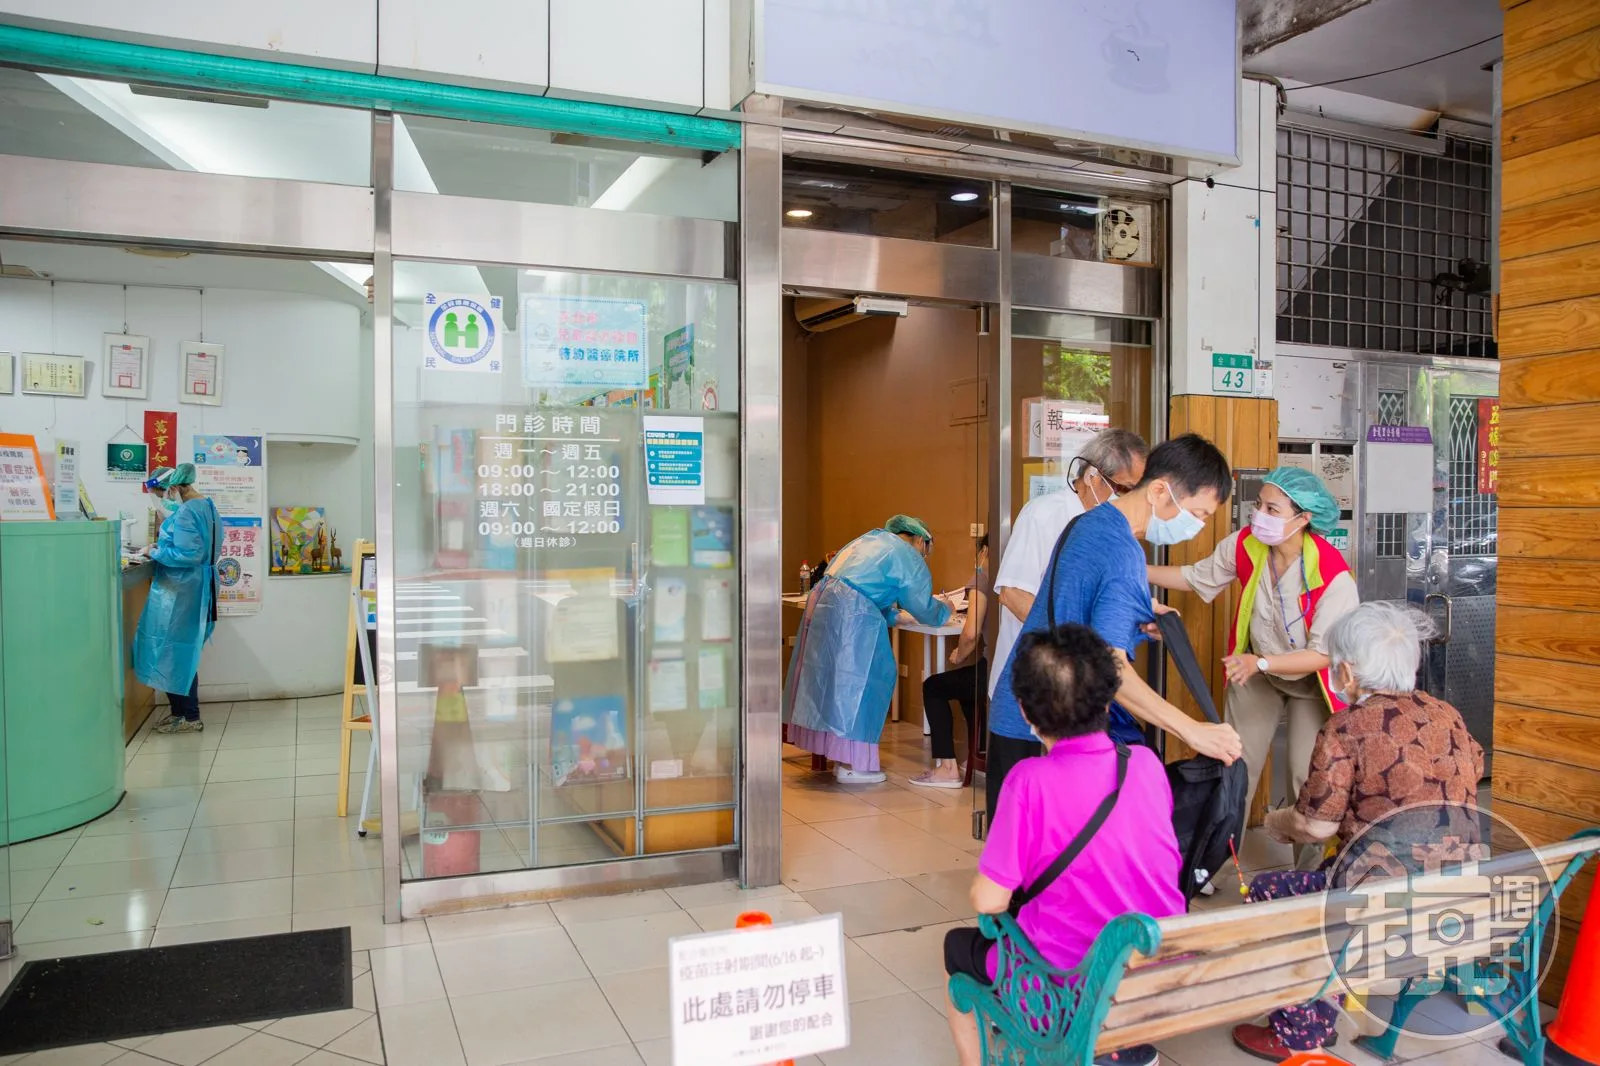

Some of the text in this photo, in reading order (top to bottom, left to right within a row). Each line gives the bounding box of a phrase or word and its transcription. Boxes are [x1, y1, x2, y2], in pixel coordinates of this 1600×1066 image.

[425, 293, 436, 304] 全
[425, 357, 436, 368] 民
[489, 360, 500, 371] 保
[1222, 371, 1245, 388] 43
[495, 414, 601, 435] 門診時間
[152, 419, 169, 468] 萬事如
[480, 500, 620, 518] 週六、國定假日
[682, 973, 836, 1025] 此處請勿停車
[749, 1012, 833, 1041] 謝謝您的配合
